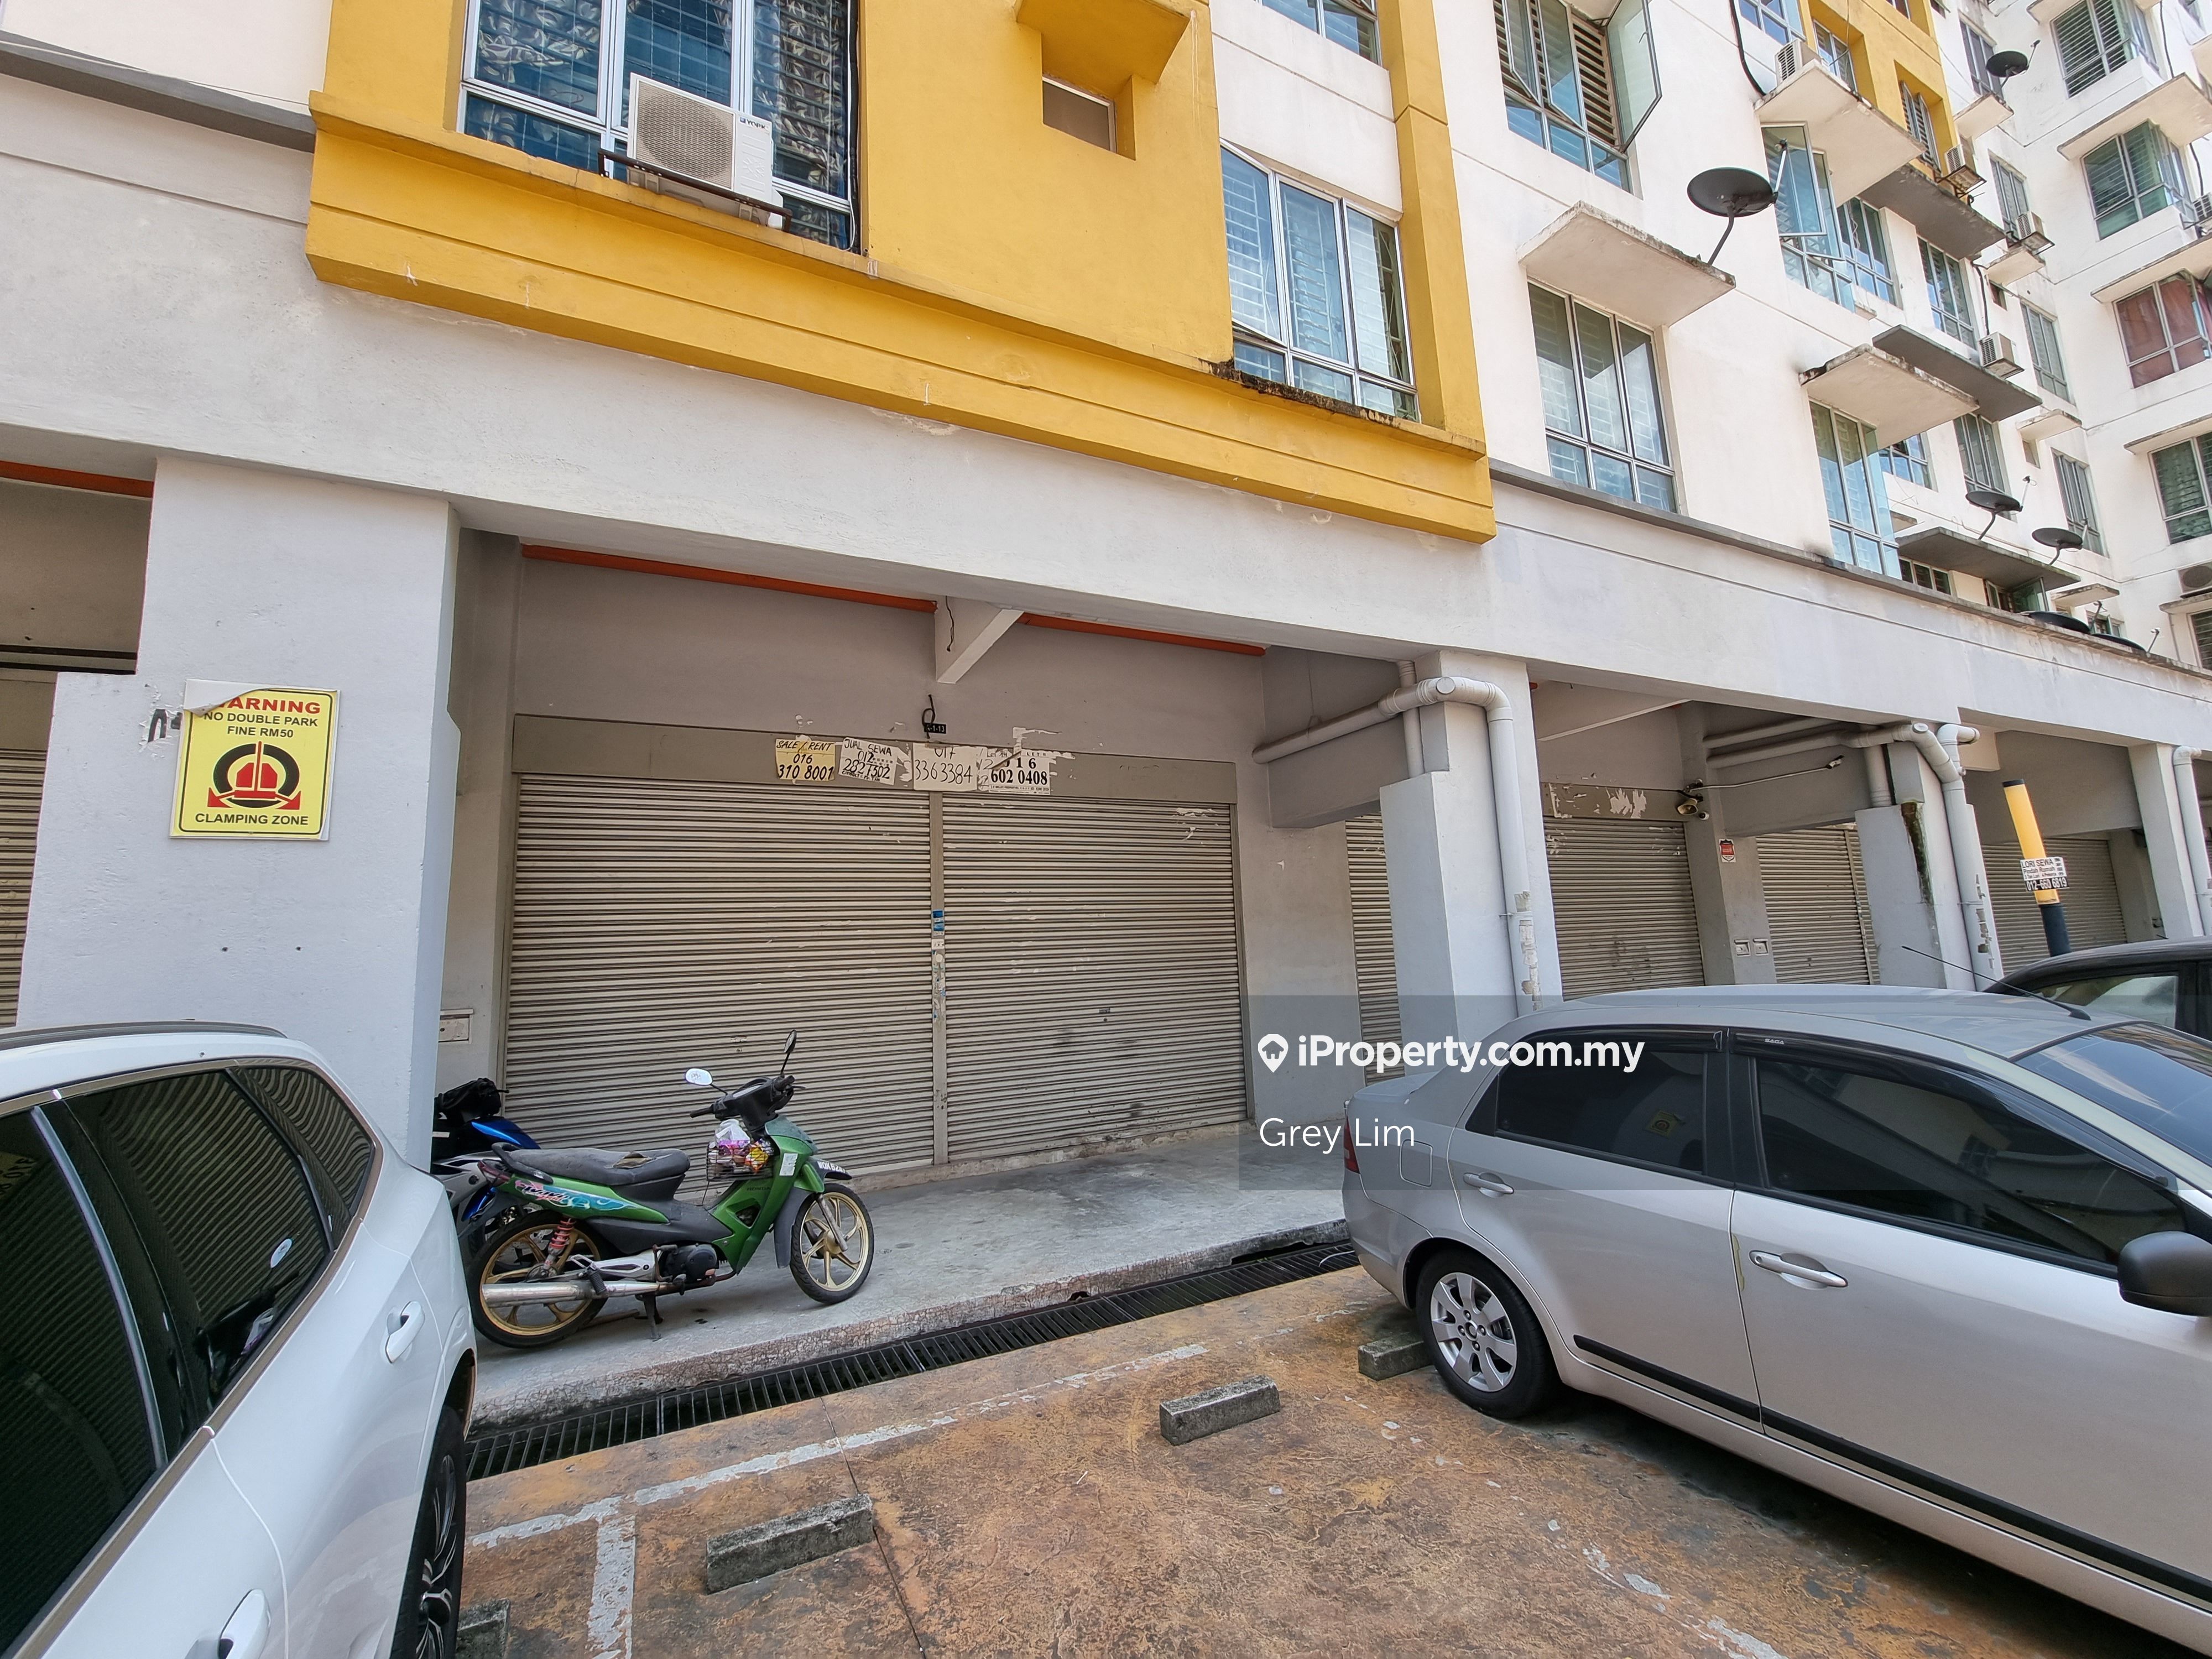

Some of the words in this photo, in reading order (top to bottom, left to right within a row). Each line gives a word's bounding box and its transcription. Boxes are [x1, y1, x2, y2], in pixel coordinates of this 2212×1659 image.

[216, 697, 321, 714] ARNING
[204, 712, 222, 721] NO
[227, 713, 280, 724] DOUBLE
[284, 717, 318, 727] PARK
[227, 726, 255, 736] FINE
[259, 728, 294, 738] RM50
[776, 740, 801, 749] SALE
[808, 742, 834, 751] RENT
[844, 739, 862, 750] JUAL
[868, 744, 892, 757] SEWA
[793, 753, 813, 764] 016
[858, 750, 874, 763] 012
[779, 764, 800, 779] 310
[804, 765, 834, 780] 8001
[990, 769, 1013, 783] 602
[1018, 770, 1047, 785] 0408
[195, 813, 268, 824] CLAMPING
[272, 816, 309, 825] ZONE
